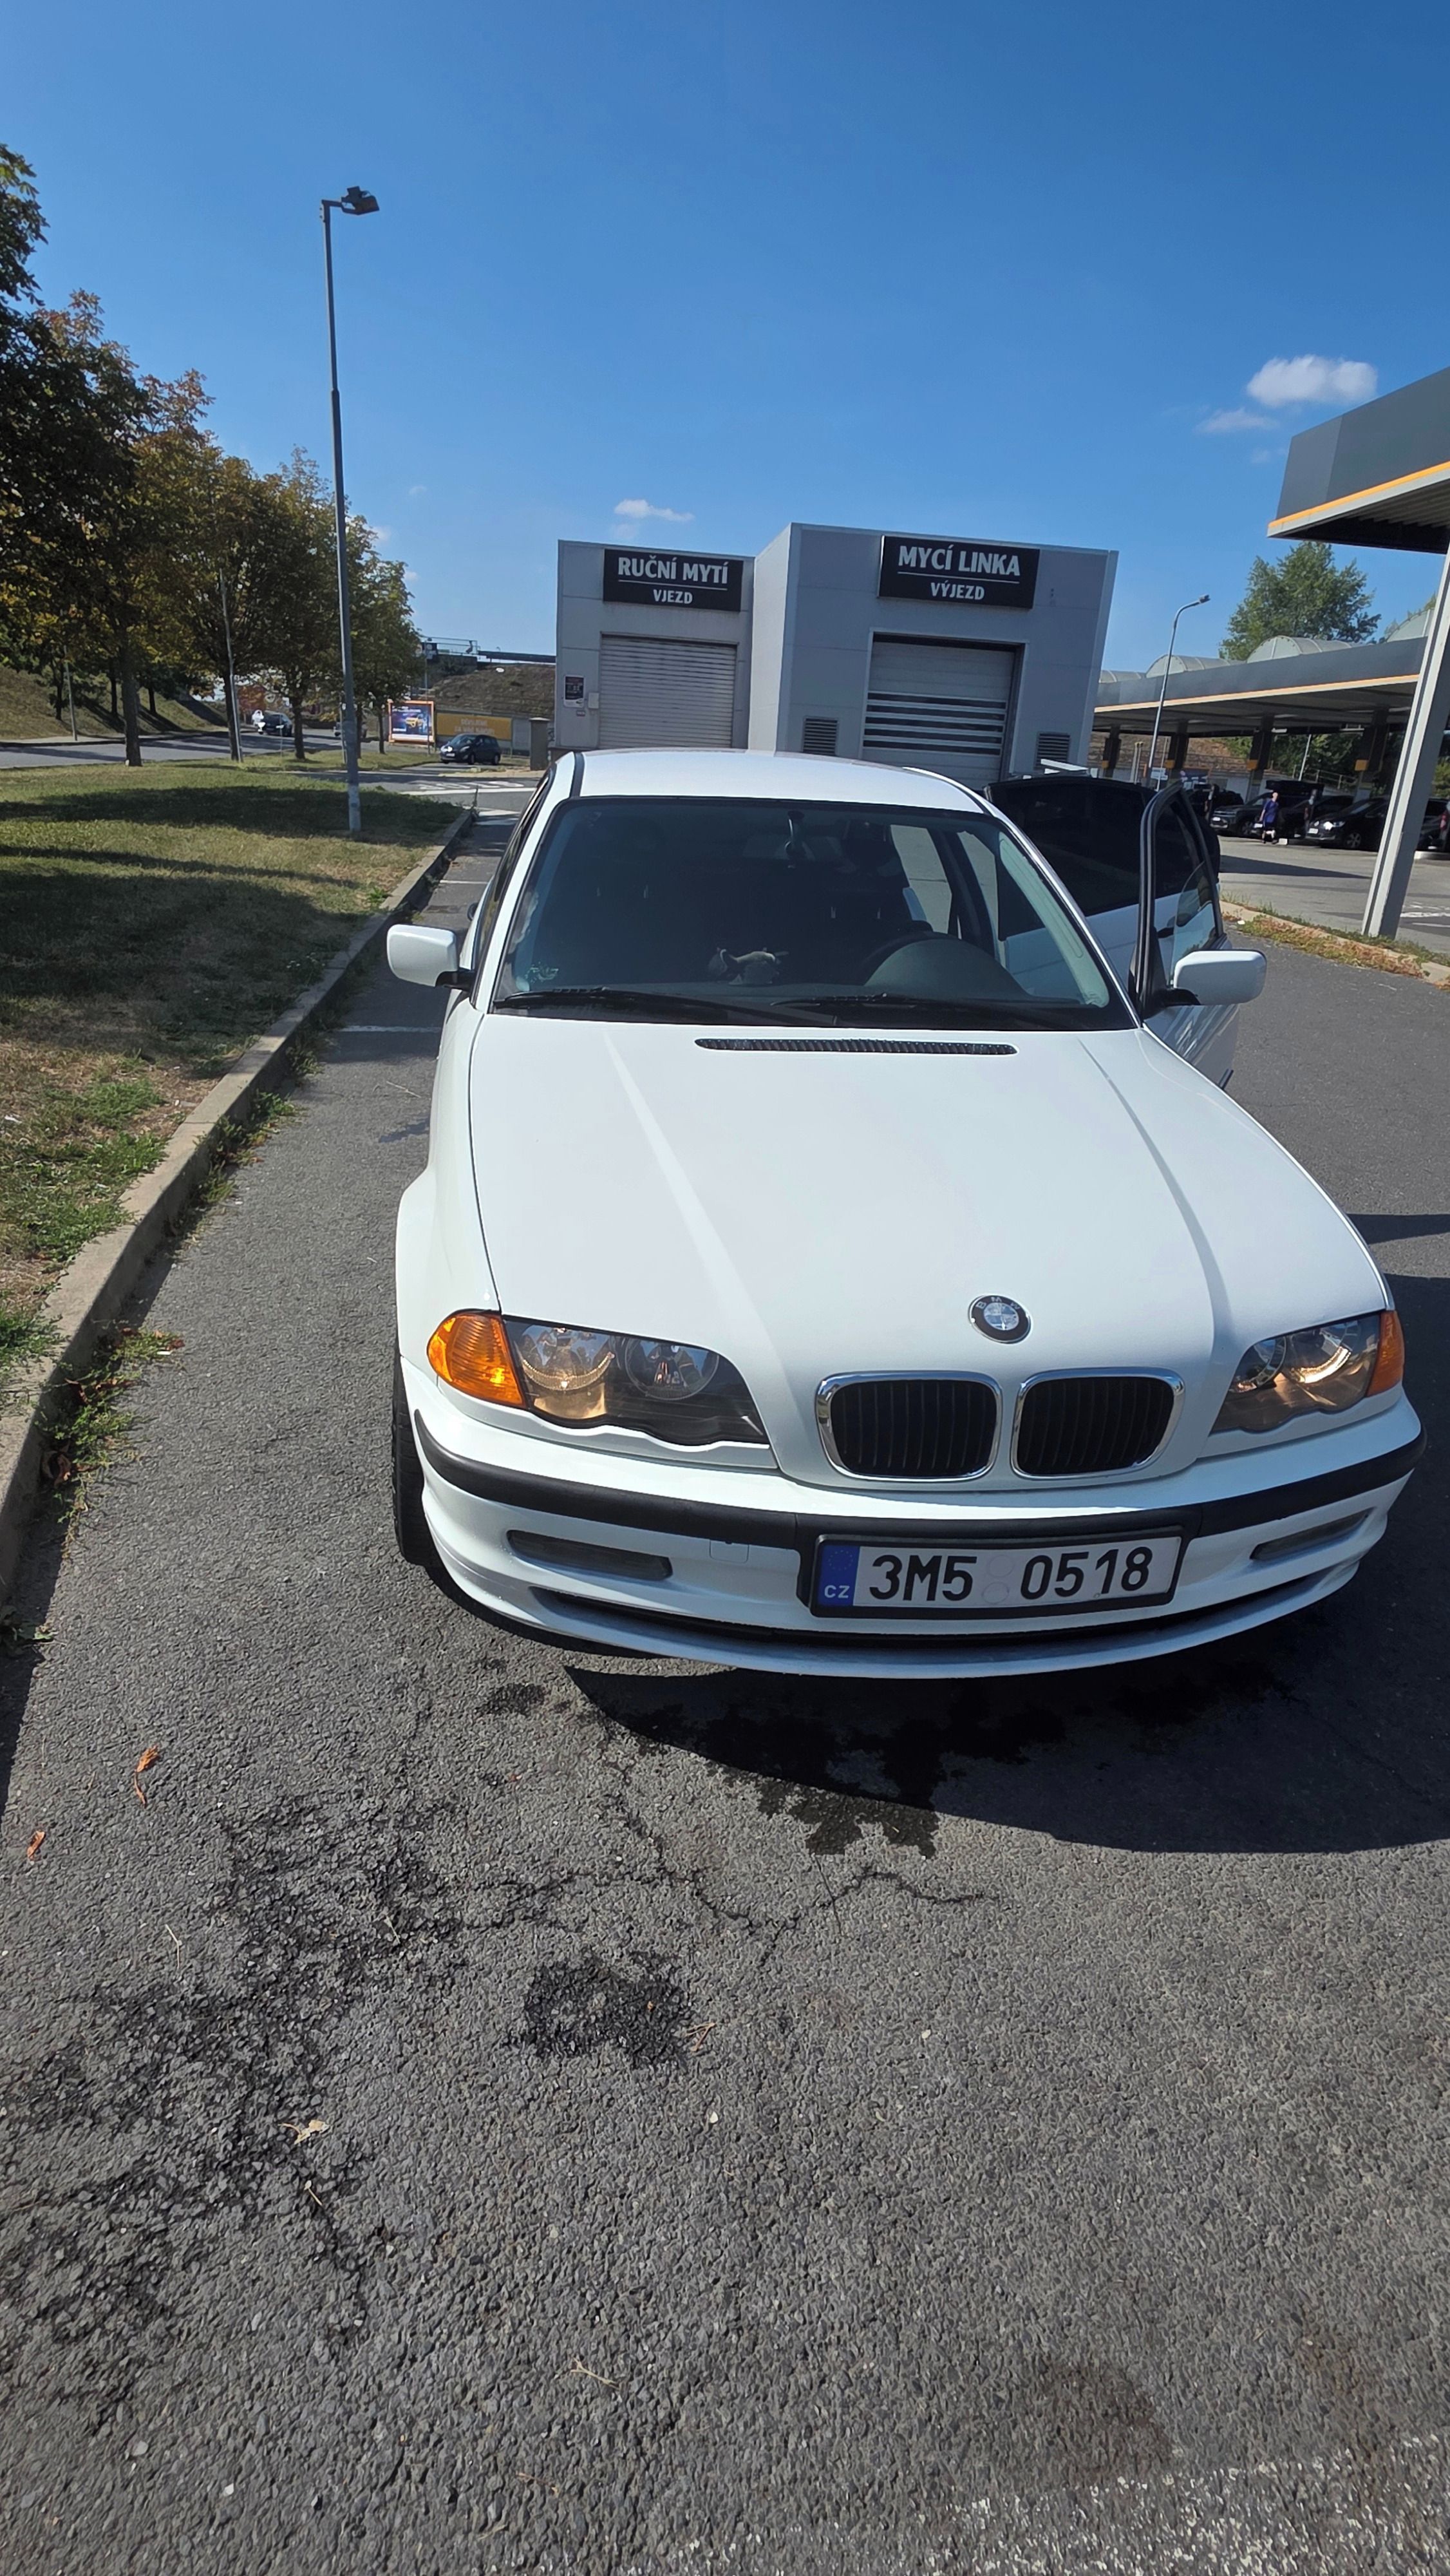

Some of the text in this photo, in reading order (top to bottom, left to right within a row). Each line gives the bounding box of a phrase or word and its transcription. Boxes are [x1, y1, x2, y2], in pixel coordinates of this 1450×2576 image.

[618, 554, 729, 584] RUČNÍ MYTÍ
[898, 544, 1021, 576] MYCÍ LINKA
[653, 589, 693, 604] VJEZD
[930, 580, 984, 600] VÝJEZD
[975, 1296, 1021, 1310] BMW
[824, 1546, 1153, 1602] CZ 3M5 0518
